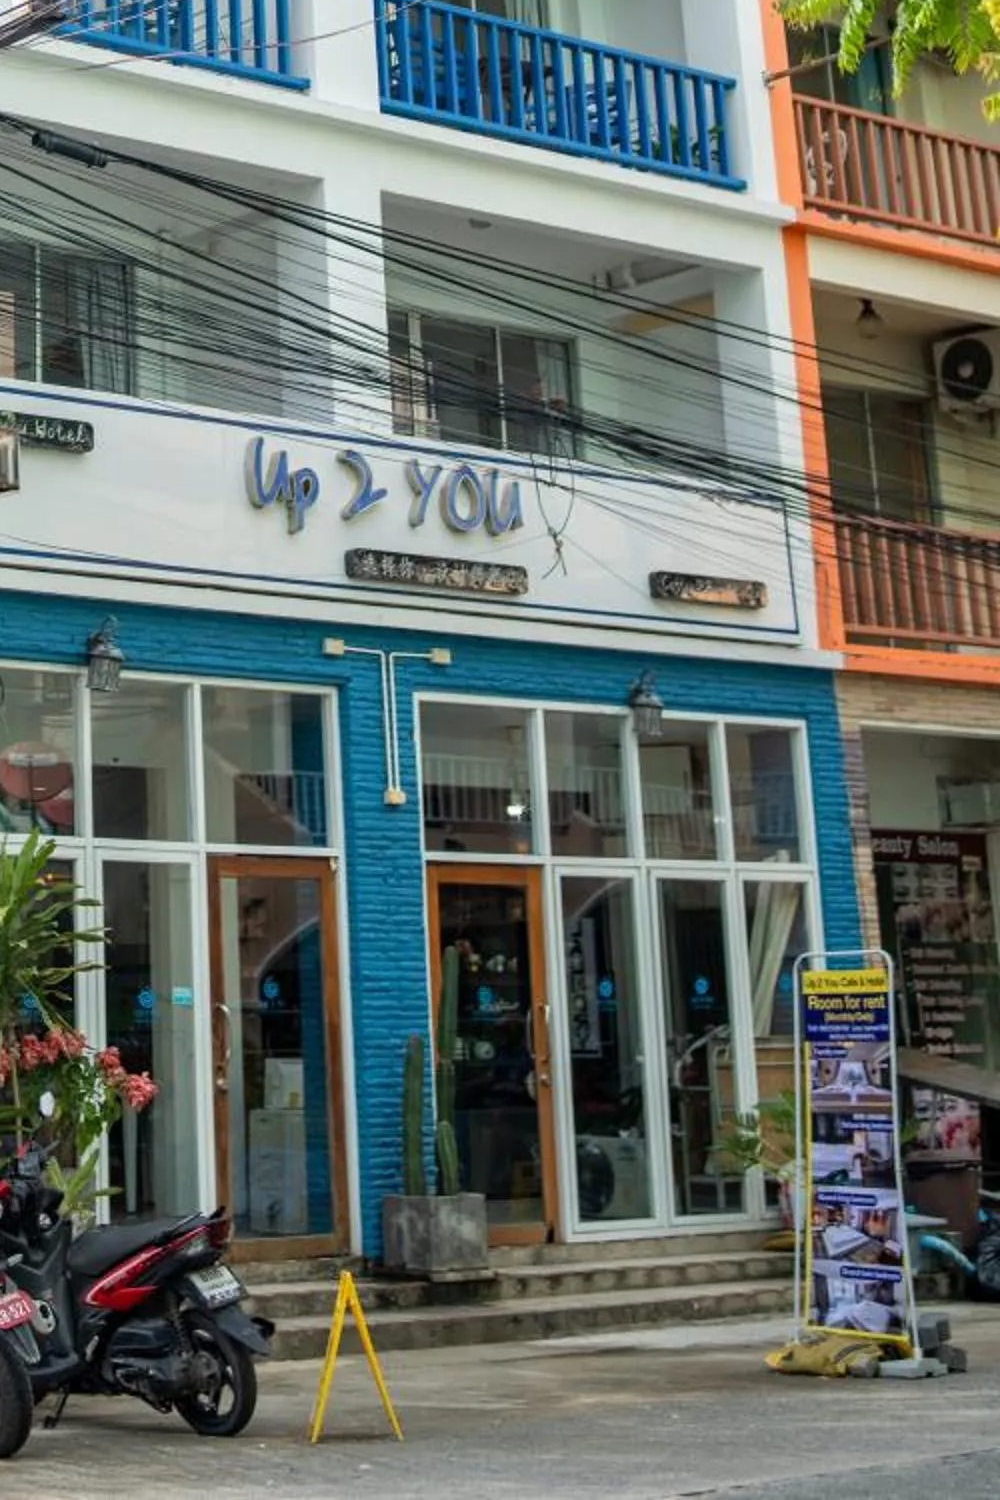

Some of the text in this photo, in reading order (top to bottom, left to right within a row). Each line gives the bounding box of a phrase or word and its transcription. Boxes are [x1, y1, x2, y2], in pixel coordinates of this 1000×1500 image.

[35, 419, 86, 443] Hotel
[245, 436, 320, 535] Up
[336, 449, 388, 521] 2
[872, 835, 959, 859] eauty Salon
[807, 995, 885, 1010] Room for rent
